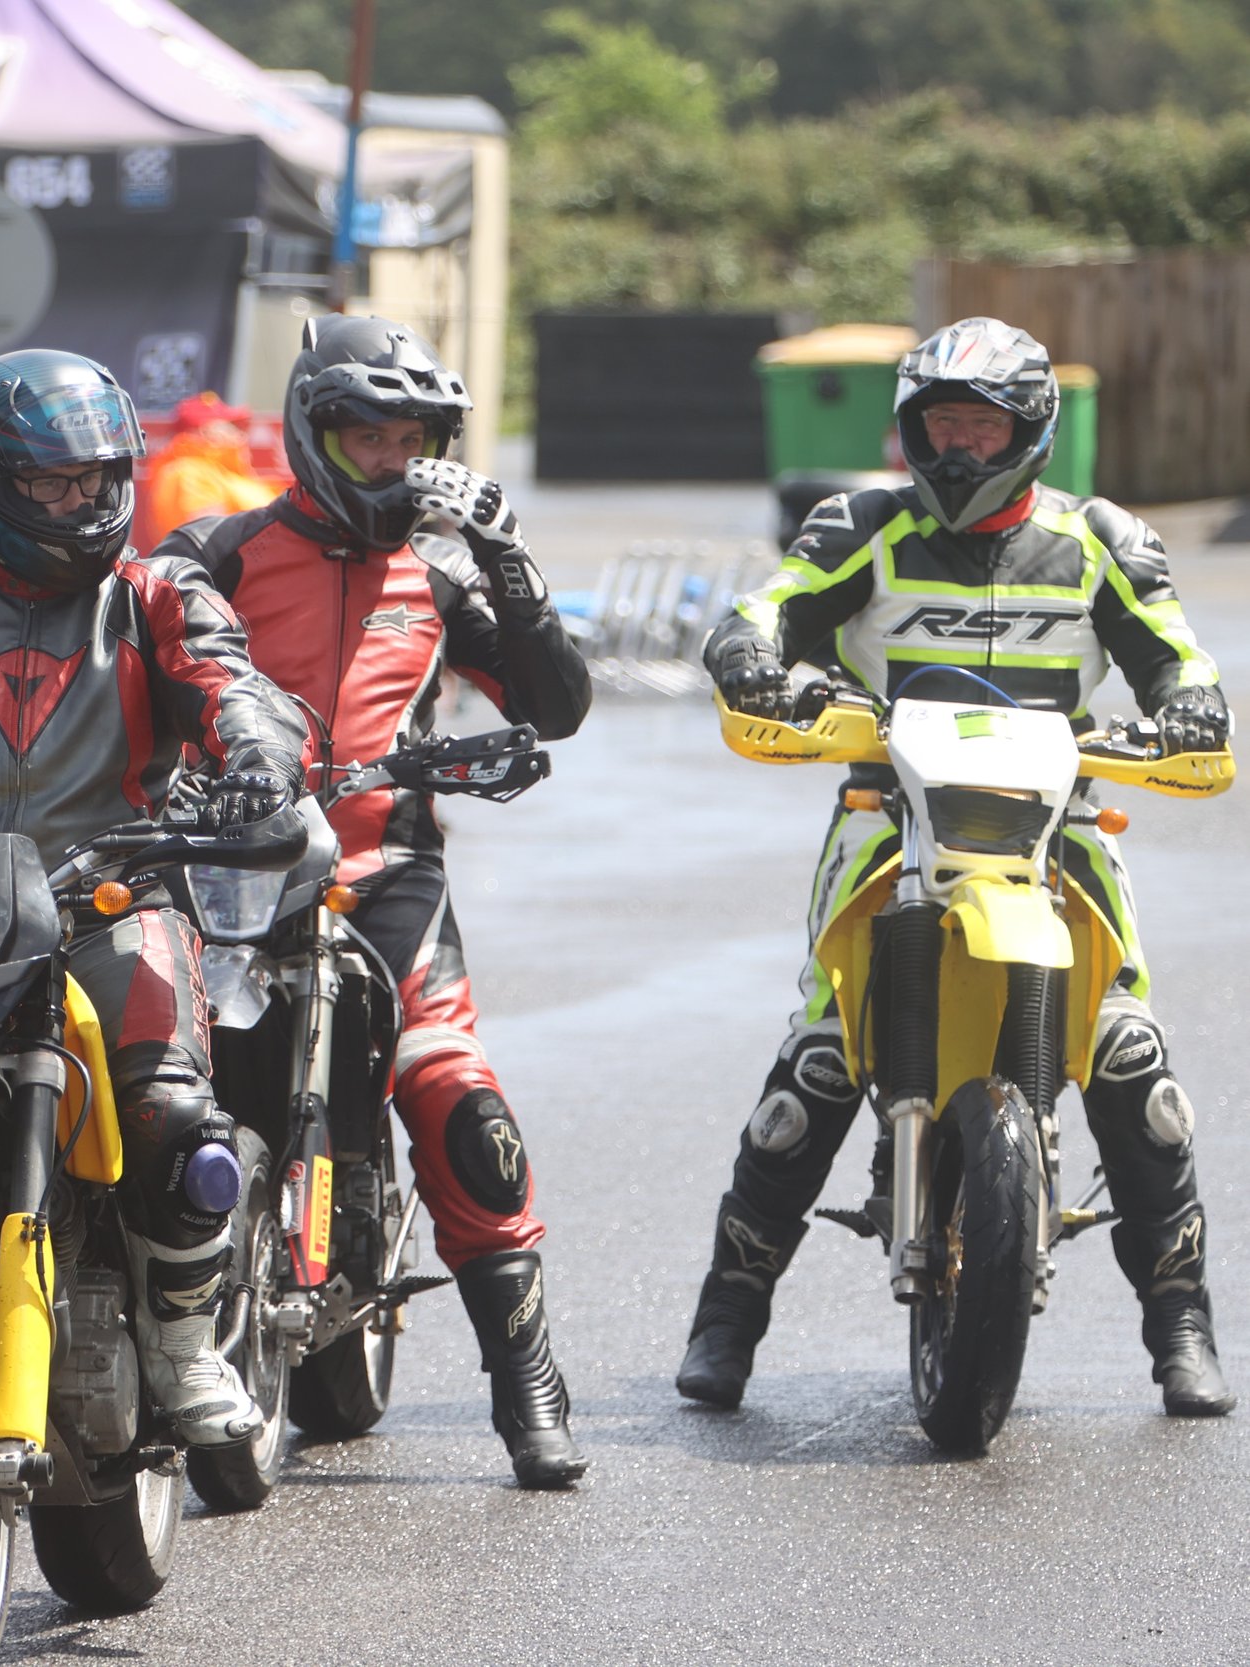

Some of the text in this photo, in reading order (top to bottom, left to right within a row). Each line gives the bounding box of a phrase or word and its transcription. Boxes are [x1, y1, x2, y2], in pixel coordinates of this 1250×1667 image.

[883, 603, 1089, 645] RST
[1144, 776, 1215, 791] Polisport
[1109, 1039, 1158, 1070] RST
